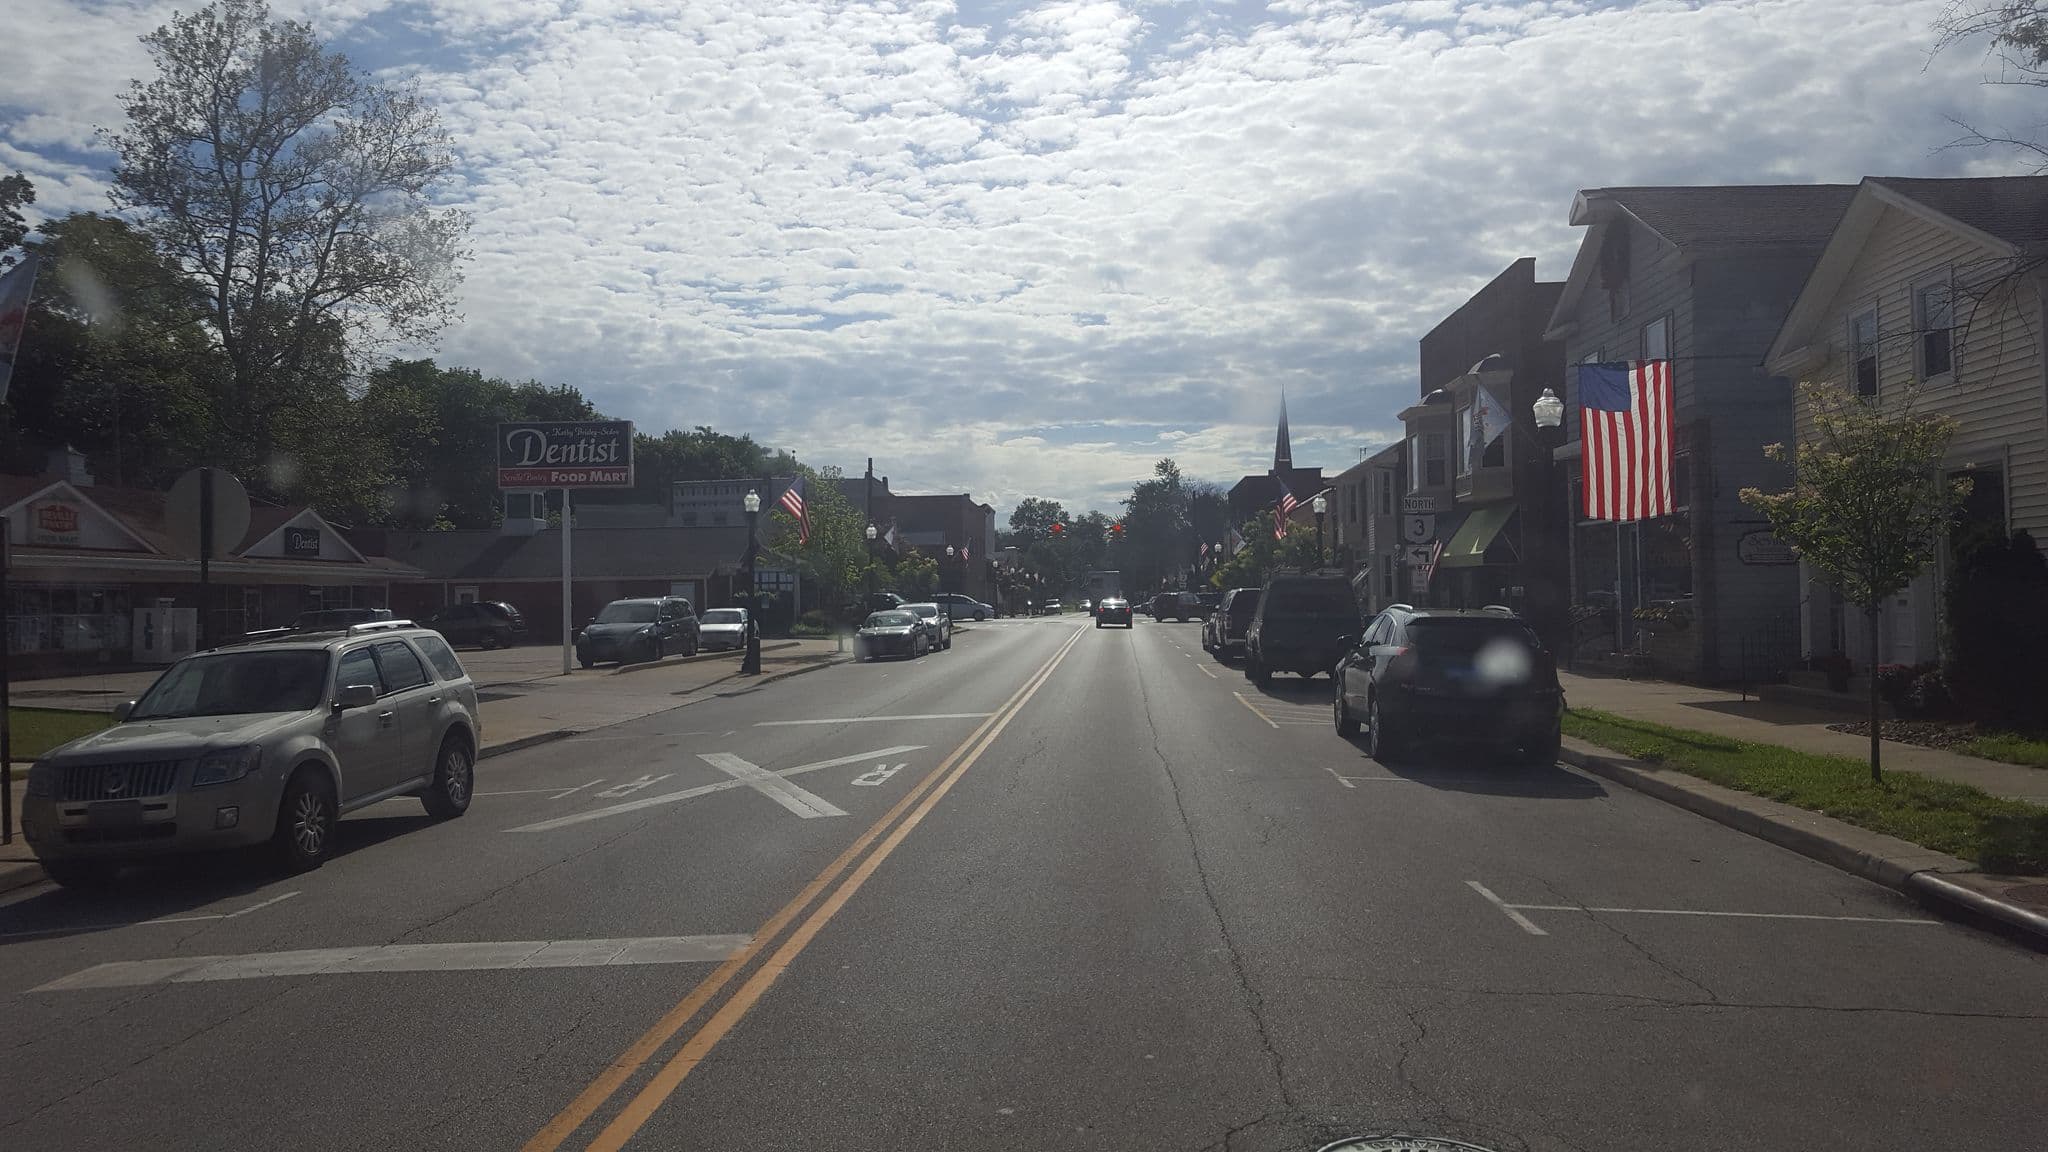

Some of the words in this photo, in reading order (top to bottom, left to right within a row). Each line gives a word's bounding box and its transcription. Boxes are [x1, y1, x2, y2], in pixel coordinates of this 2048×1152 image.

[506, 428, 620, 466] Dentist
[551, 471, 587, 482] FOOD
[590, 470, 627, 482] MART
[1404, 498, 1434, 509] NORTH
[1414, 519, 1425, 536] 3
[292, 533, 318, 549] Dentist
